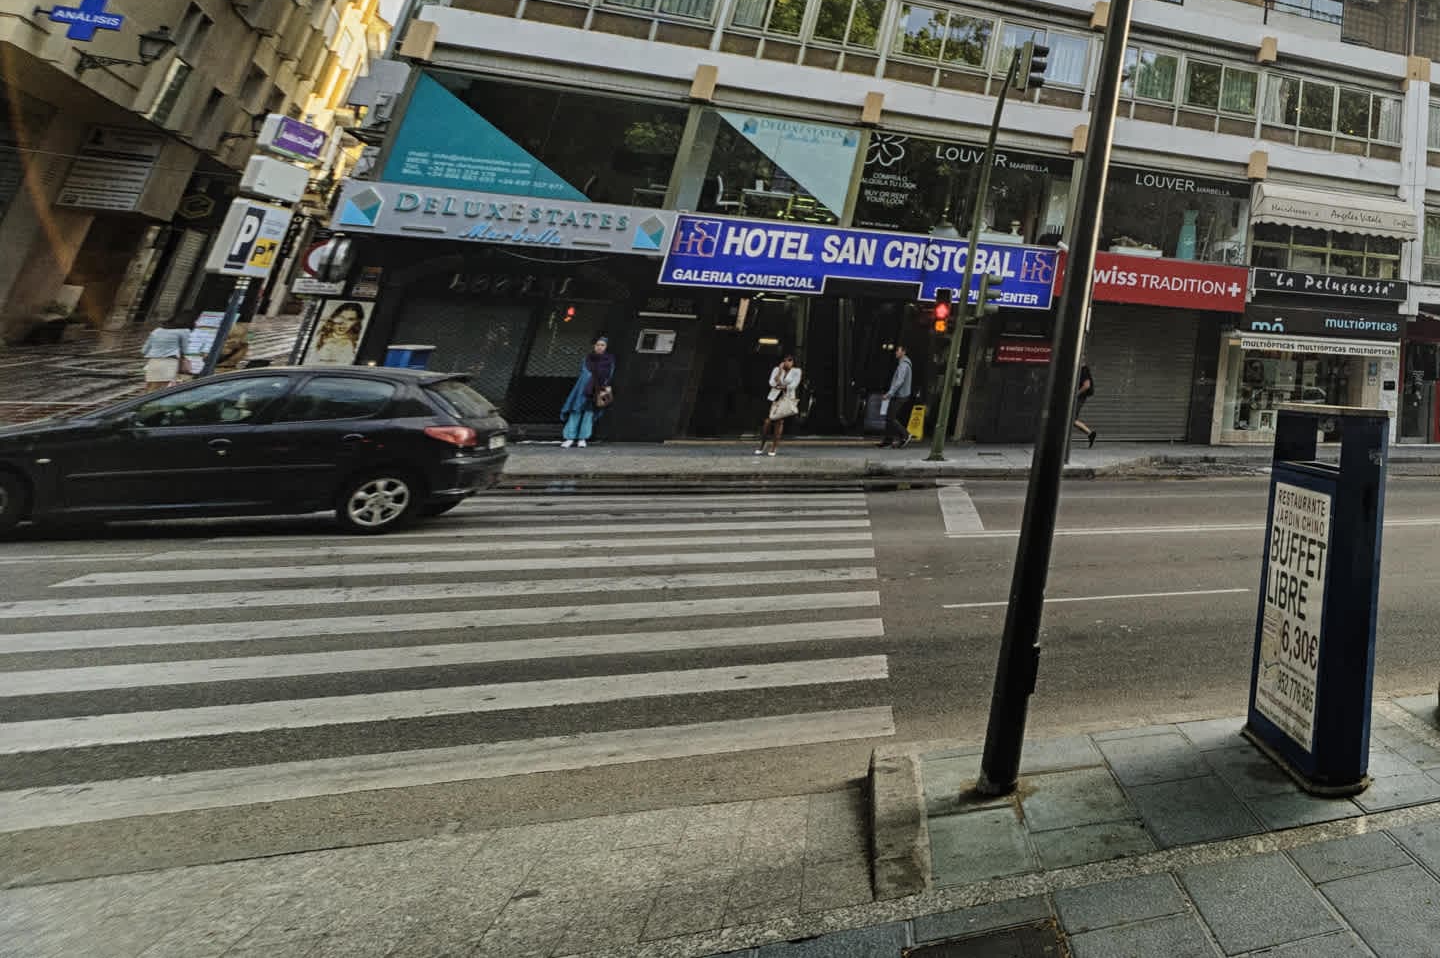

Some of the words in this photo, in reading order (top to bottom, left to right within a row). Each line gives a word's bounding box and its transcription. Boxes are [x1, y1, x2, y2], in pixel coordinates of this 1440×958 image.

[1009, 162, 1049, 173] MARBELLA
[1135, 173, 1195, 193] LOUVER
[231, 214, 260, 256] P
[458, 221, 562, 246] Marbella
[722, 226, 814, 262] HOTEL
[820, 233, 877, 267] SAN
[672, 268, 733, 285] GALERIA
[736, 272, 815, 289] COMERCIAL
[1140, 273, 1226, 296] TRADITION
[1278, 489, 1326, 517] RESTAURANTE
[1302, 515, 1325, 537] CHINO
[1270, 525, 1327, 581] BUFFET
[1266, 564, 1309, 622] LIBRE
[1281, 619, 1318, 671] 6,30€
